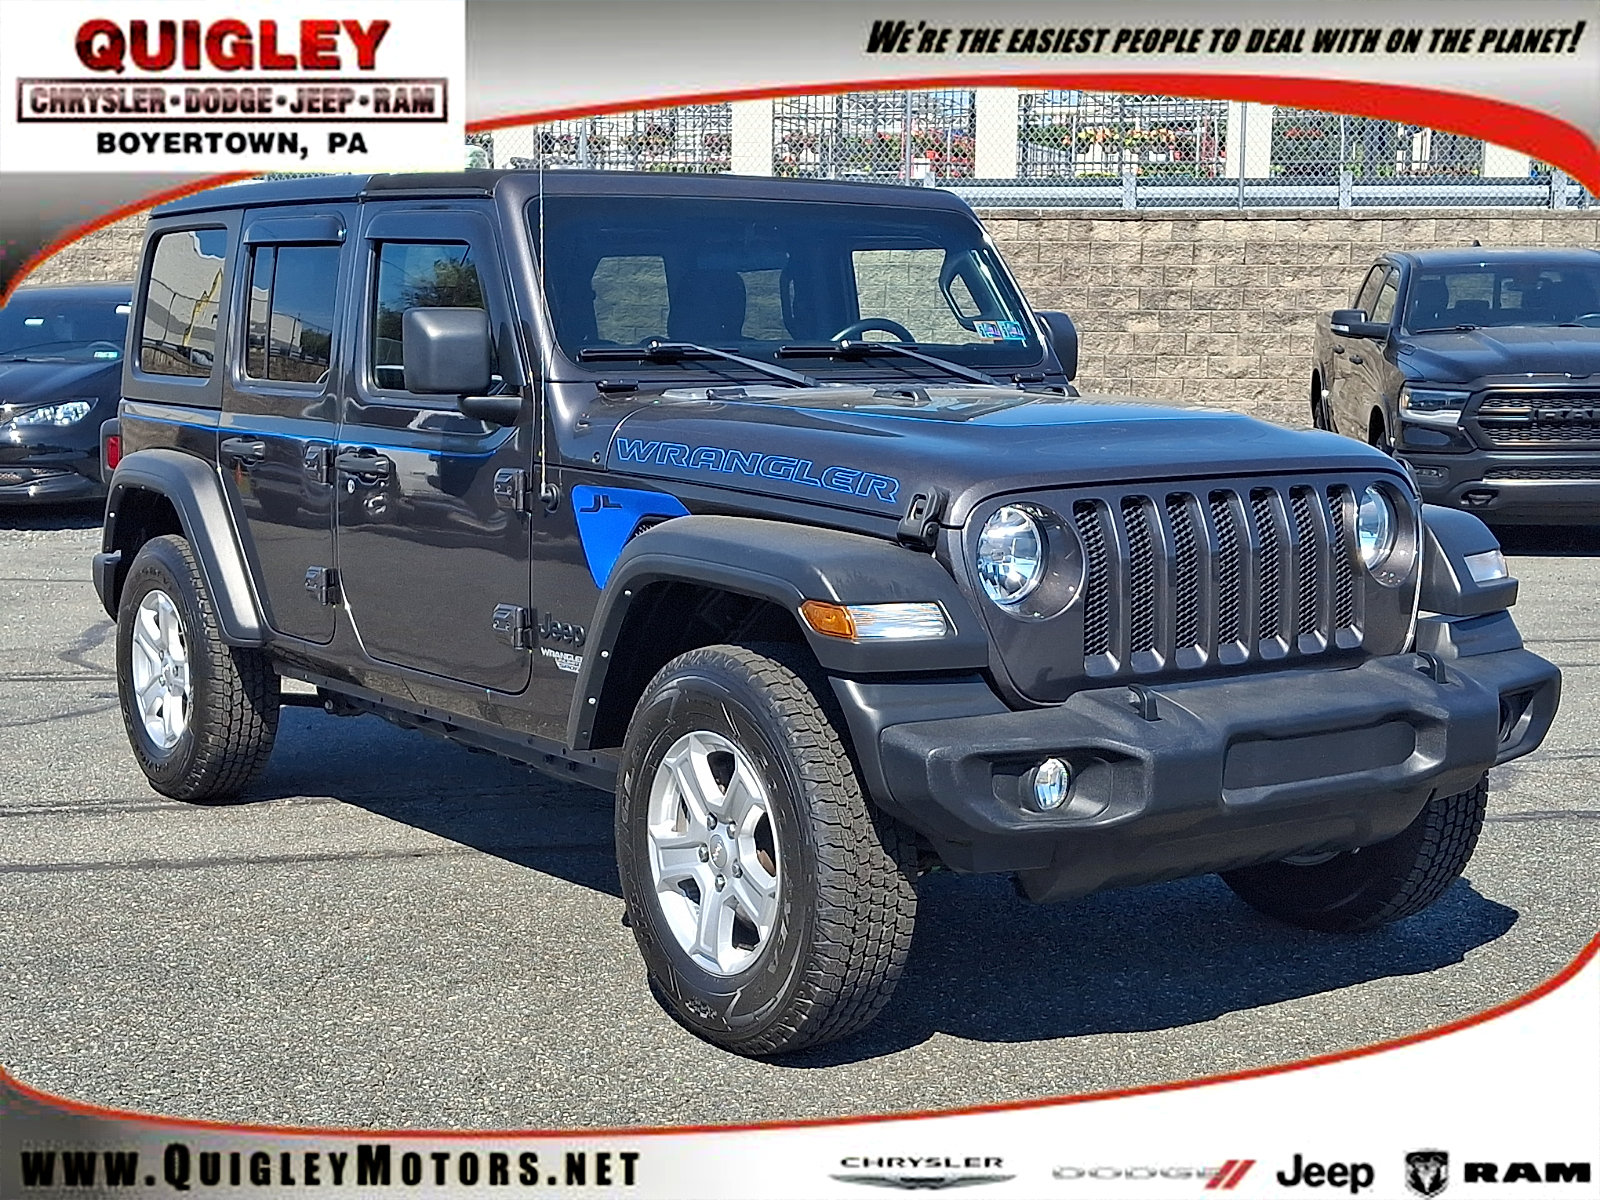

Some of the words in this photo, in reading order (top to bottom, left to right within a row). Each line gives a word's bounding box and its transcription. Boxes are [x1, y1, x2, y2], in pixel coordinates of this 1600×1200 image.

[615, 437, 901, 504] WRANGLER
[580, 494, 623, 513] JL
[539, 612, 586, 647] Jeep
